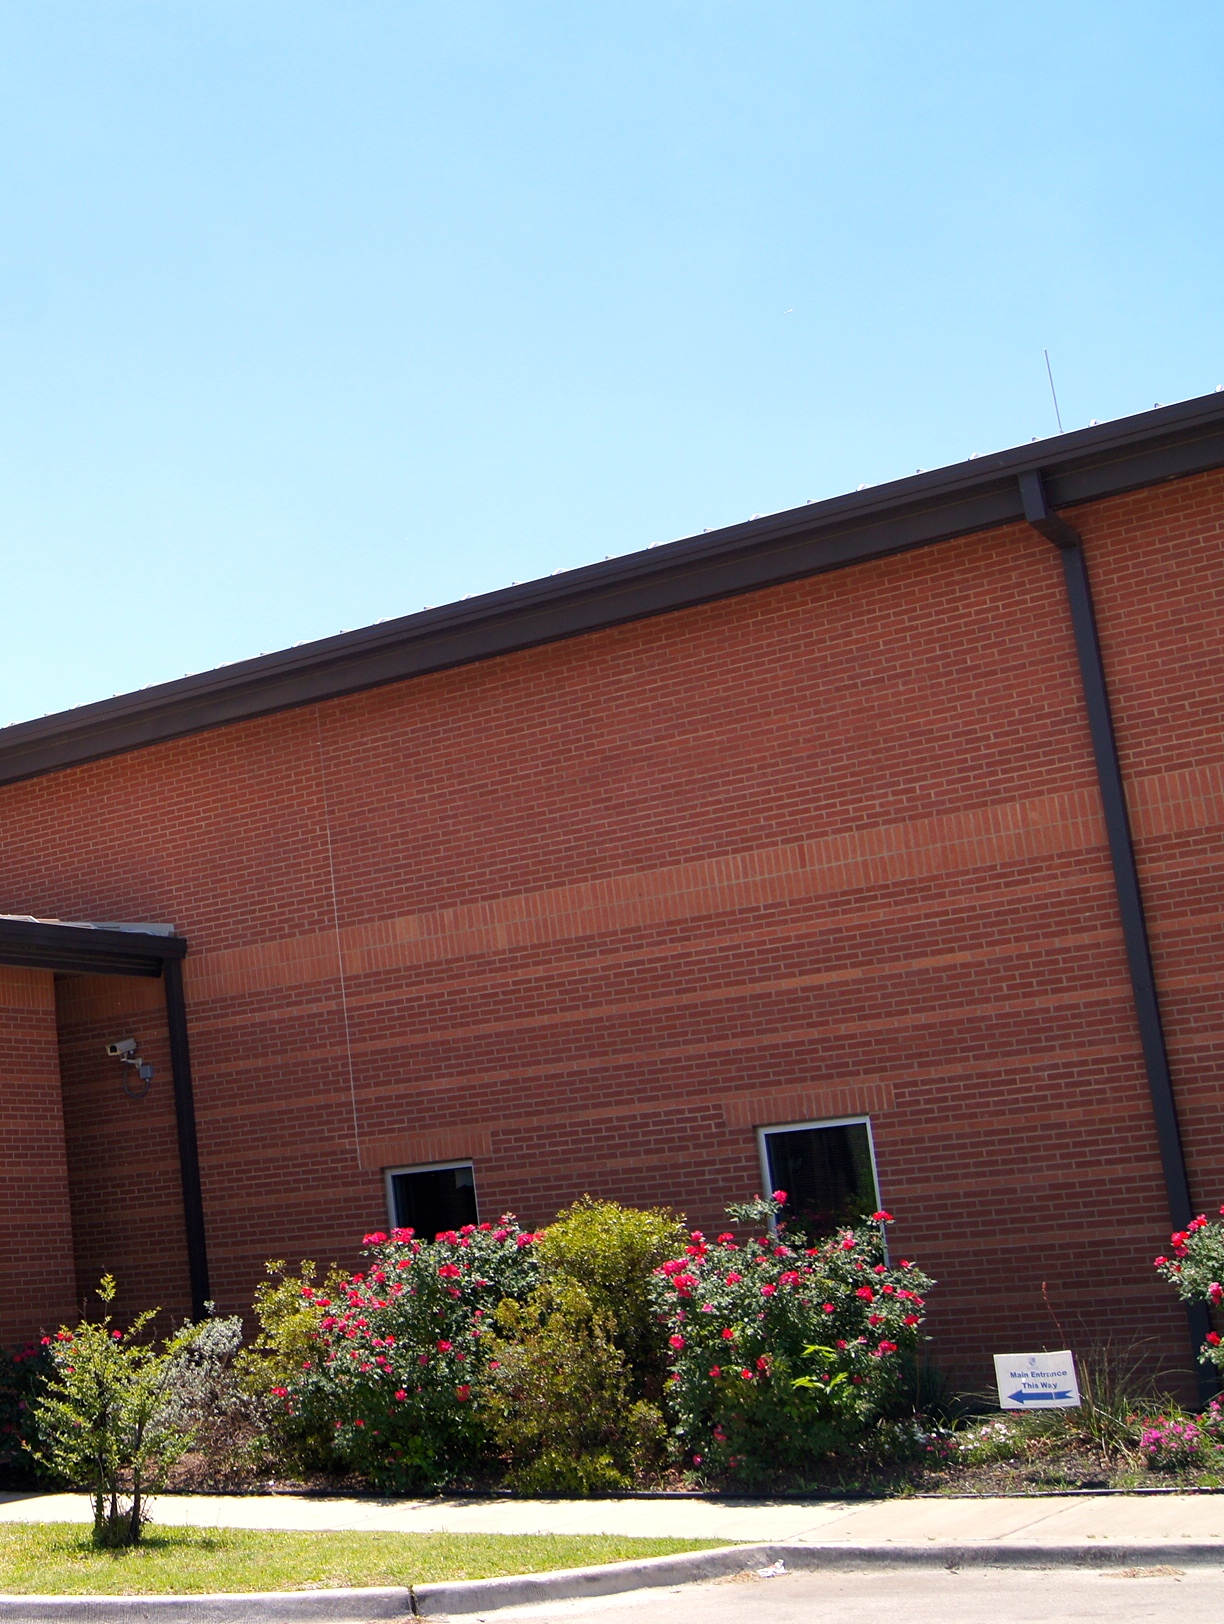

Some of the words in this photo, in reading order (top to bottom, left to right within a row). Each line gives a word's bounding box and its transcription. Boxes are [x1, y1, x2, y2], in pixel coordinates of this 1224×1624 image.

[1010, 1371, 1029, 1379] Main
[1030, 1370, 1068, 1378] Entrance
[1041, 1382, 1058, 1391] Way
